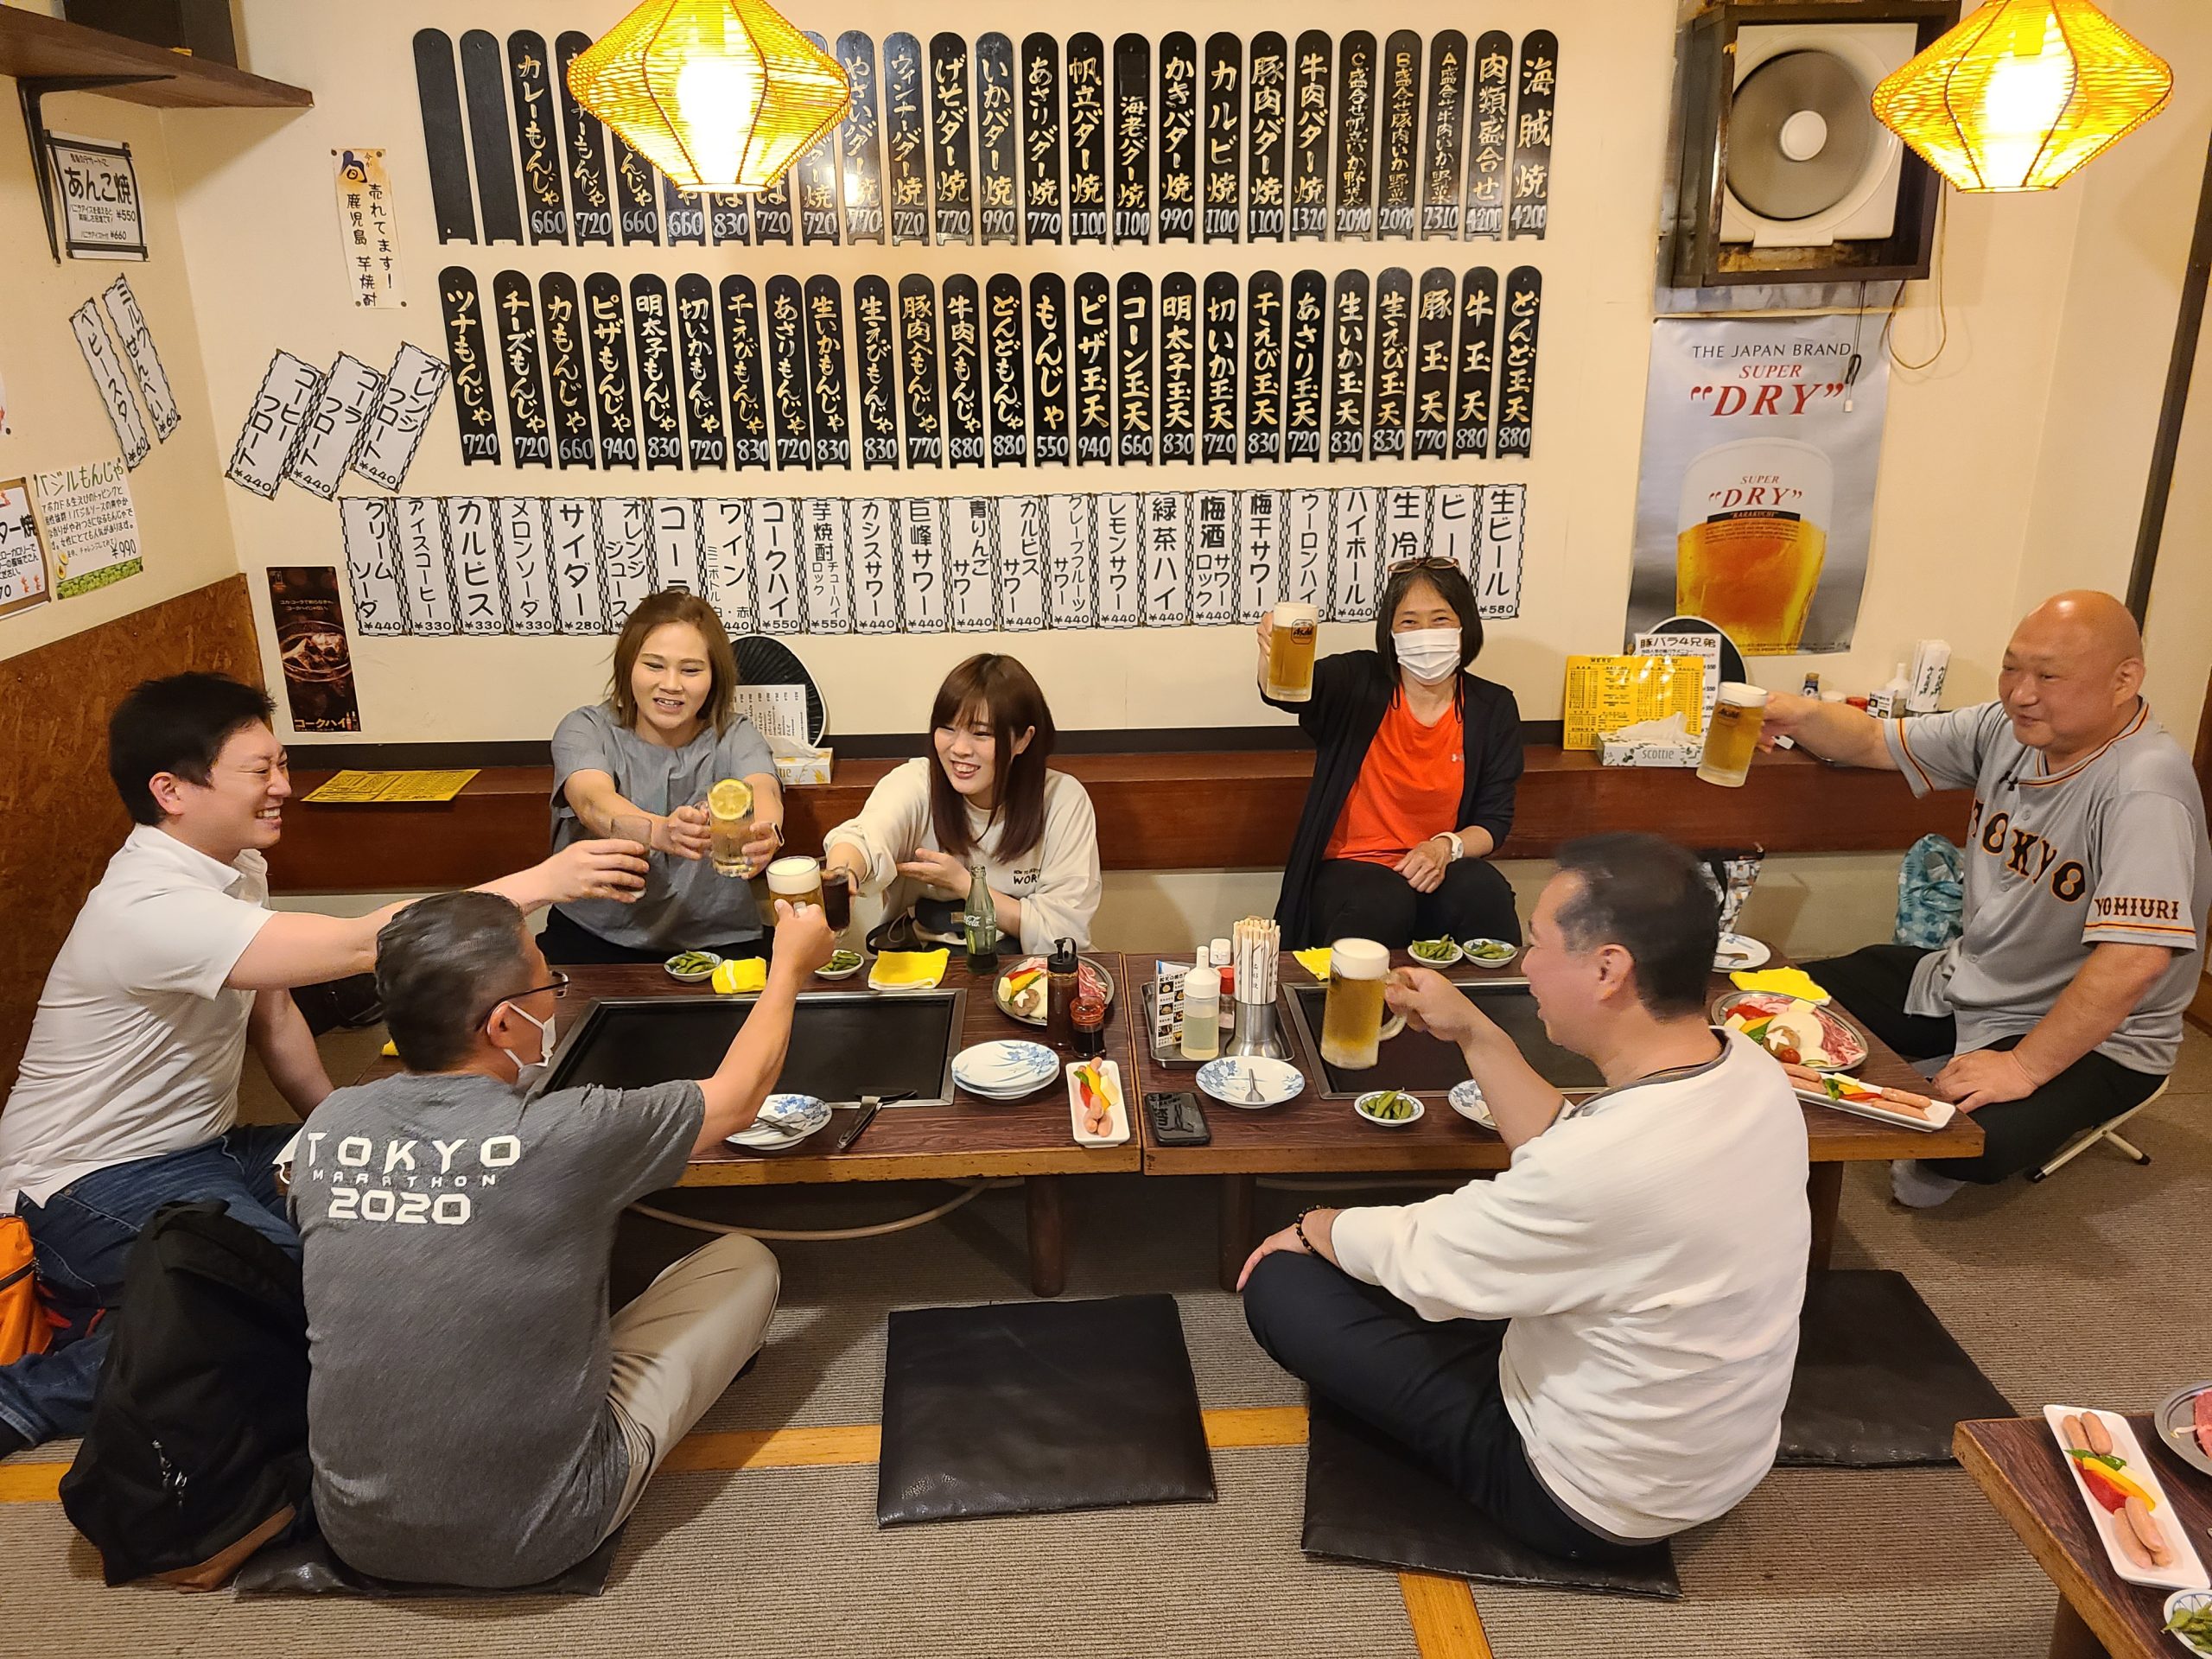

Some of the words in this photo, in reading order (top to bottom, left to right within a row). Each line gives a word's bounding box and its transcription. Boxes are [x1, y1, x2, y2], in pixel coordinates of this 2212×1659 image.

[518, 55, 560, 207] カレーもんじゃ
[936, 54, 969, 202] げそバター焼
[982, 59, 1013, 206] いかバター焼
[1028, 56, 1058, 206] あさりバター焼
[1069, 56, 1103, 204] 帆立バター焼
[1162, 56, 1194, 202] かきバター焼
[1207, 60, 1237, 205] カルビ焼
[1251, 55, 1285, 205] 豚肉バター焼
[1294, 53, 1328, 204] 牛肉バター焼
[1473, 53, 1509, 200] 肉類盛合せ
[1515, 57, 1554, 199] 海賊焼
[64, 167, 131, 205] あんこ焼
[117, 209, 136, 221] ¥550
[346, 193, 367, 245] 鹿児島
[531, 210, 567, 234] 660
[575, 212, 612, 236] 720
[623, 211, 658, 233] 660
[668, 211, 703, 237] 660
[714, 213, 748, 238] 830
[756, 210, 791, 234] 720
[804, 211, 836, 236] 720
[894, 212, 925, 236] 720
[938, 210, 971, 235] 770
[982, 210, 1014, 233] 990
[1027, 212, 1060, 235] 770
[1071, 212, 1106, 236] 1100
[1115, 212, 1149, 236] 1100
[1160, 208, 1193, 231] 990
[1205, 208, 1239, 233] 1100
[1250, 208, 1283, 233] 1100
[1292, 207, 1326, 231] 1320
[1337, 208, 1370, 231] 2090
[1424, 207, 1459, 229] 2310
[1465, 207, 1502, 232] 4200
[1510, 205, 1546, 230] 4200
[356, 256, 378, 307] 芋焼酎
[447, 290, 492, 426] ツナもんじゃ
[503, 290, 545, 433] チーズもんじゃ
[593, 294, 632, 433] ピザもんじゃ
[636, 294, 677, 431] 明太子もんじゃ
[679, 298, 720, 433] 切いかもんじゃ
[774, 294, 806, 435] あさりもんじゃ
[811, 296, 844, 433] 生いかもんじゃ
[860, 295, 893, 434] 生えびもんじゃ
[902, 294, 938, 433] 豚肉入もんじゃ
[947, 295, 981, 433] 牛肉入もんじゃ
[993, 296, 1023, 429] どんどもんじゃ
[1035, 294, 1065, 429] もんじゃ
[1078, 294, 1109, 428] ピザ玉天
[1123, 297, 1151, 431] コーン玉天
[1163, 294, 1192, 428] 明太子玉天
[1207, 297, 1236, 429] 切いか玉天
[1291, 291, 1320, 427] あさり玉天
[1334, 291, 1363, 425] 生いか玉天
[1376, 291, 1408, 426] 生えび玉天
[1417, 289, 1452, 423] 豚玉天
[1459, 289, 1493, 422] 牛玉天
[1503, 290, 1539, 423] どんど玉天
[1693, 346, 1725, 358] THE
[1731, 344, 1786, 358] JAPAN
[1793, 343, 1852, 357] BRAND
[1738, 364, 1802, 379] SUPER
[280, 368, 318, 442] コーヒー
[345, 370, 379, 424] コーラ
[397, 359, 443, 432] オレンジ
[238, 395, 281, 467] フロート
[300, 397, 343, 467] フロート
[363, 388, 406, 459] フロート
[463, 434, 498, 454] 720
[515, 436, 549, 458] 720
[560, 438, 594, 460] 660
[648, 436, 680, 458] 830
[864, 438, 897, 460] 830
[909, 437, 941, 460] 770
[950, 436, 983, 459] 880
[993, 435, 1027, 456] 880
[1037, 435, 1069, 457] 550
[1078, 435, 1110, 457] 940
[1122, 435, 1153, 455] 660
[1163, 434, 1194, 454] 830
[1204, 434, 1236, 454] 720
[1248, 433, 1279, 454] 830
[1287, 431, 1319, 453] 720
[1331, 431, 1363, 453] 830
[1372, 429, 1405, 452] 830
[1415, 429, 1446, 449] 770
[1456, 427, 1487, 448] 880
[1498, 427, 1530, 448] 880
[359, 461, 397, 485] ¥440
[602, 438, 636, 461] 940
[690, 440, 723, 460] 720
[736, 439, 769, 461] 830
[778, 439, 810, 460] 720
[817, 439, 849, 461] 830
[35, 461, 124, 498] バジルもんじゃ
[234, 467, 272, 492] ¥440
[294, 468, 331, 493] ¥440
[1740, 474, 1780, 485] SUPER
[365, 501, 393, 580] クリーム
[623, 500, 645, 579] オレンジ
[721, 504, 746, 587] ワイン
[813, 502, 834, 562] 芋焼酎
[969, 500, 989, 576] 青りんご
[1020, 500, 1039, 575] カルピス
[1200, 496, 1225, 548] 梅酒
[1485, 489, 1515, 596] 生ビール
[408, 500, 435, 618] アイスコーヒー
[457, 500, 493, 616] カルピス
[512, 500, 540, 618] メロンソーダ
[560, 504, 590, 616] サイダー
[707, 546, 721, 602] ミニボトル
[763, 502, 789, 618] コークハイ
[862, 502, 883, 616] カシスサワー
[910, 501, 933, 615] 巨峰サワー
[1069, 496, 1085, 612] グレープフルーツ
[1109, 498, 1127, 610] レモンサワー
[1153, 498, 1178, 610] 緑茶ハイ
[1250, 494, 1272, 607] 梅干サワー
[1300, 494, 1319, 603] ウーロンハイ
[1346, 492, 1367, 605] ハイボール
[353, 562, 378, 619] ソーダ
[606, 541, 629, 617] ジュース
[812, 563, 823, 595] ロック
[828, 562, 841, 618] チューハイ
[953, 560, 970, 614] サワー
[1003, 559, 1020, 613] サワー
[1054, 557, 1069, 605] サワー
[1197, 555, 1212, 607] ロック
[1214, 554, 1230, 607] サワー
[811, 620, 847, 628] ¥550
[1149, 613, 1183, 621] ¥440
[1196, 611, 1230, 620] ¥440
[1338, 607, 1372, 616] ¥440
[1479, 605, 1513, 613] ¥580
[1643, 749, 1674, 760] scottie
[1014, 874, 1039, 885] WOR
[2094, 897, 2179, 921] YOMIURI
[308, 1133, 521, 1175] TOKYO
[313, 1169, 497, 1189] MARATHON
[328, 1187, 471, 1225] 2020
